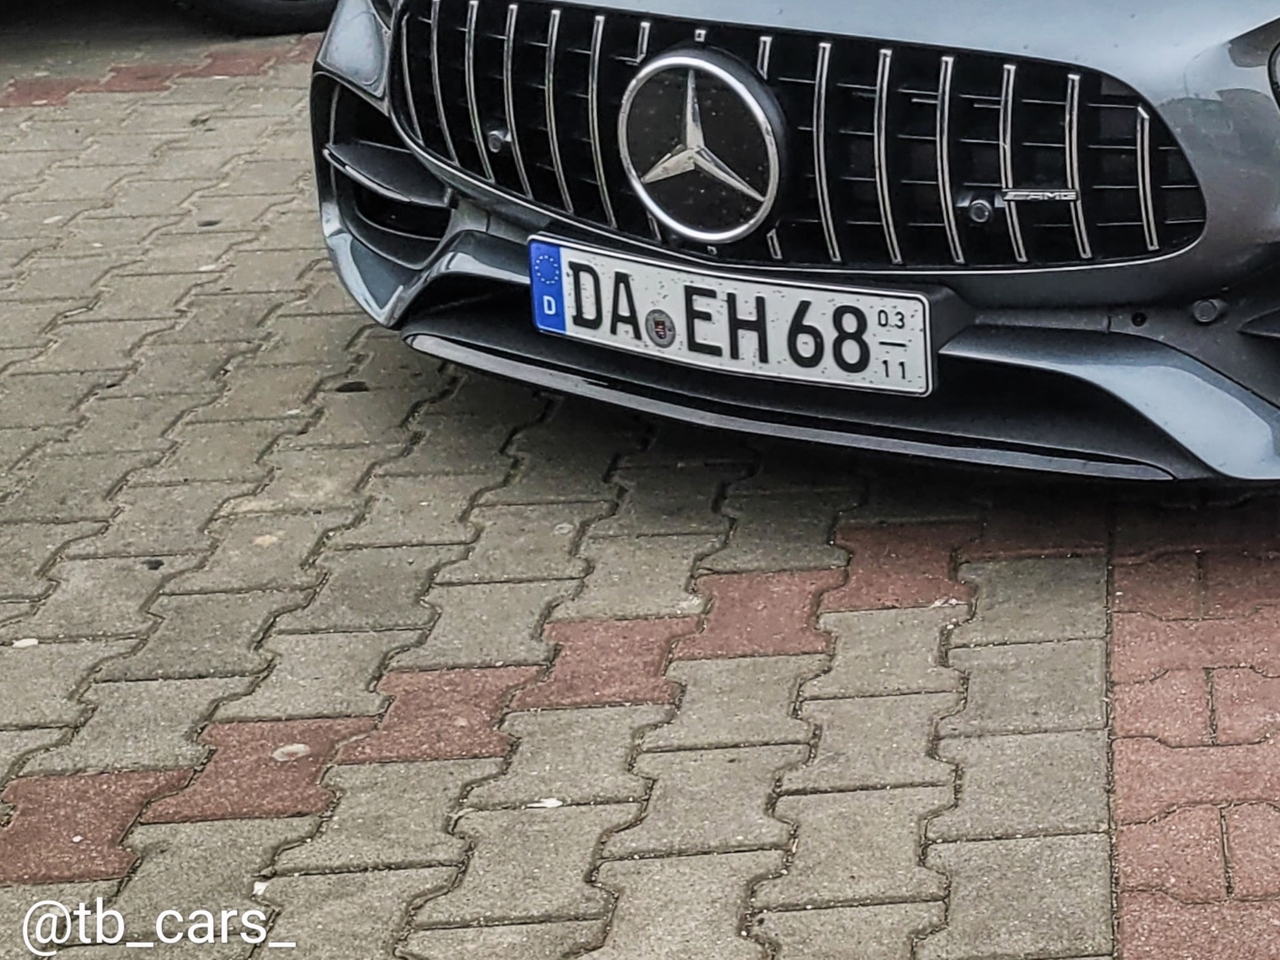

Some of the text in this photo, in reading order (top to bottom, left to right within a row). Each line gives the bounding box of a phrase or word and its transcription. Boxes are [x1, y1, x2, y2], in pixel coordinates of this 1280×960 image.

[543, 295, 557, 316] D
[568, 260, 642, 341] DA
[877, 309, 905, 330] 03
[882, 358, 907, 380] 11
